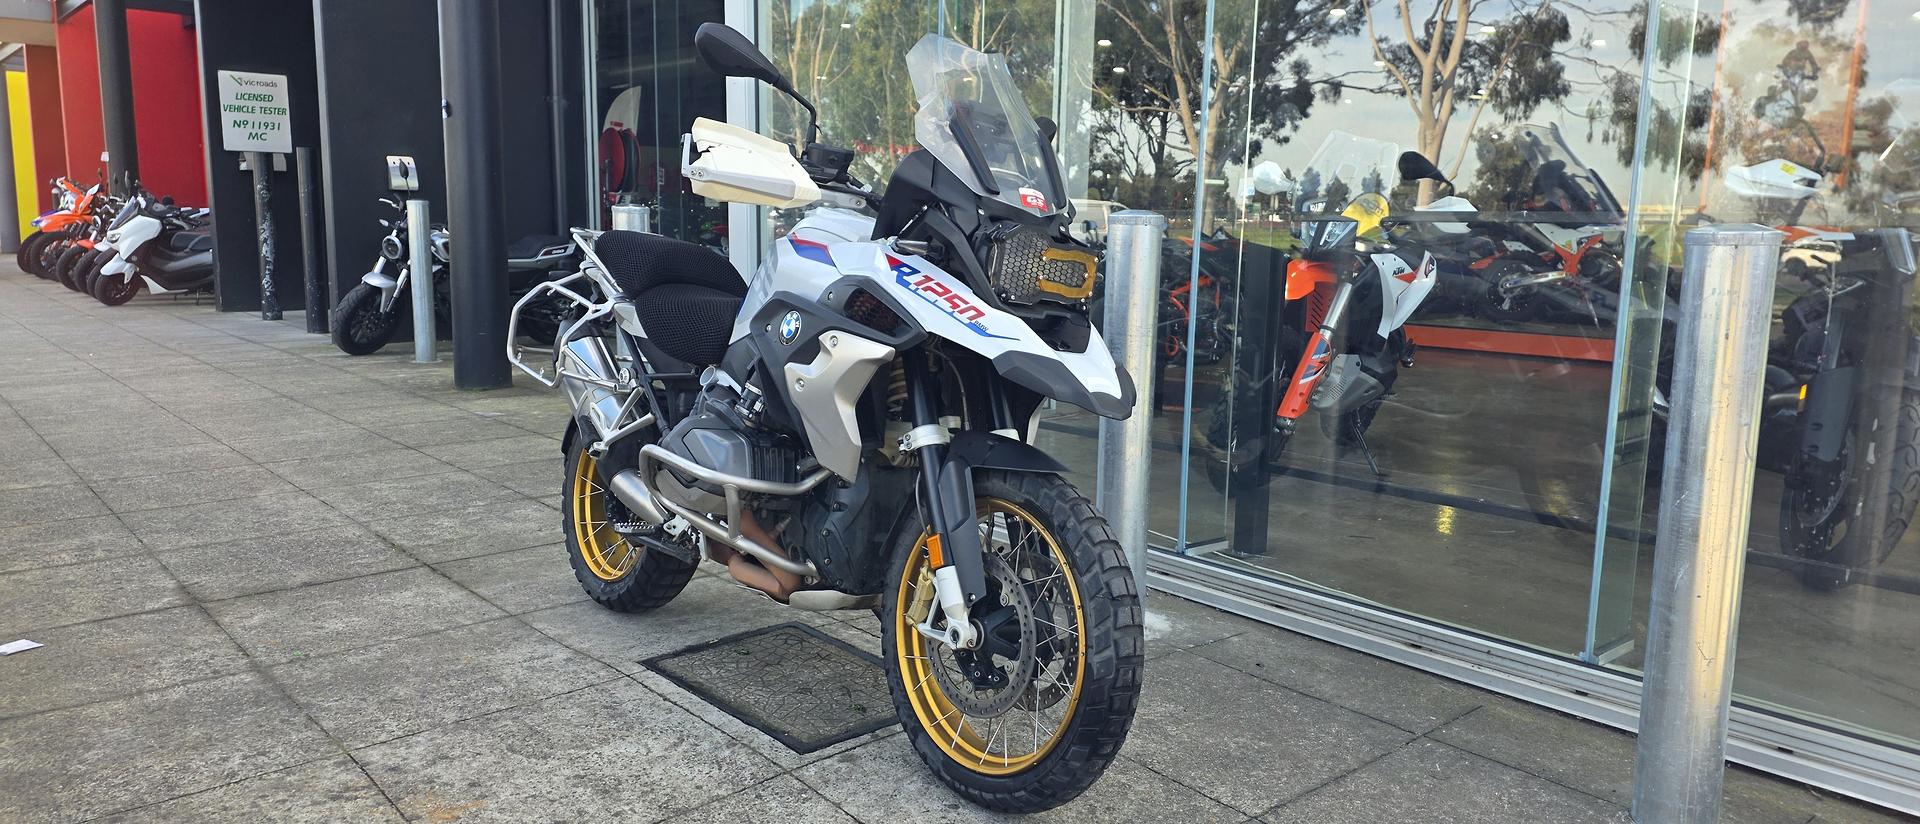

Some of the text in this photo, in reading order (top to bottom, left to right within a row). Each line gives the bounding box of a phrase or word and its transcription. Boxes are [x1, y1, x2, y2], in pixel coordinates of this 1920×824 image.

[235, 92, 274, 102] LICENSED
[223, 104, 287, 116] VEHICLE TESTER
[252, 120, 281, 131] 11931
[247, 131, 268, 141] MC
